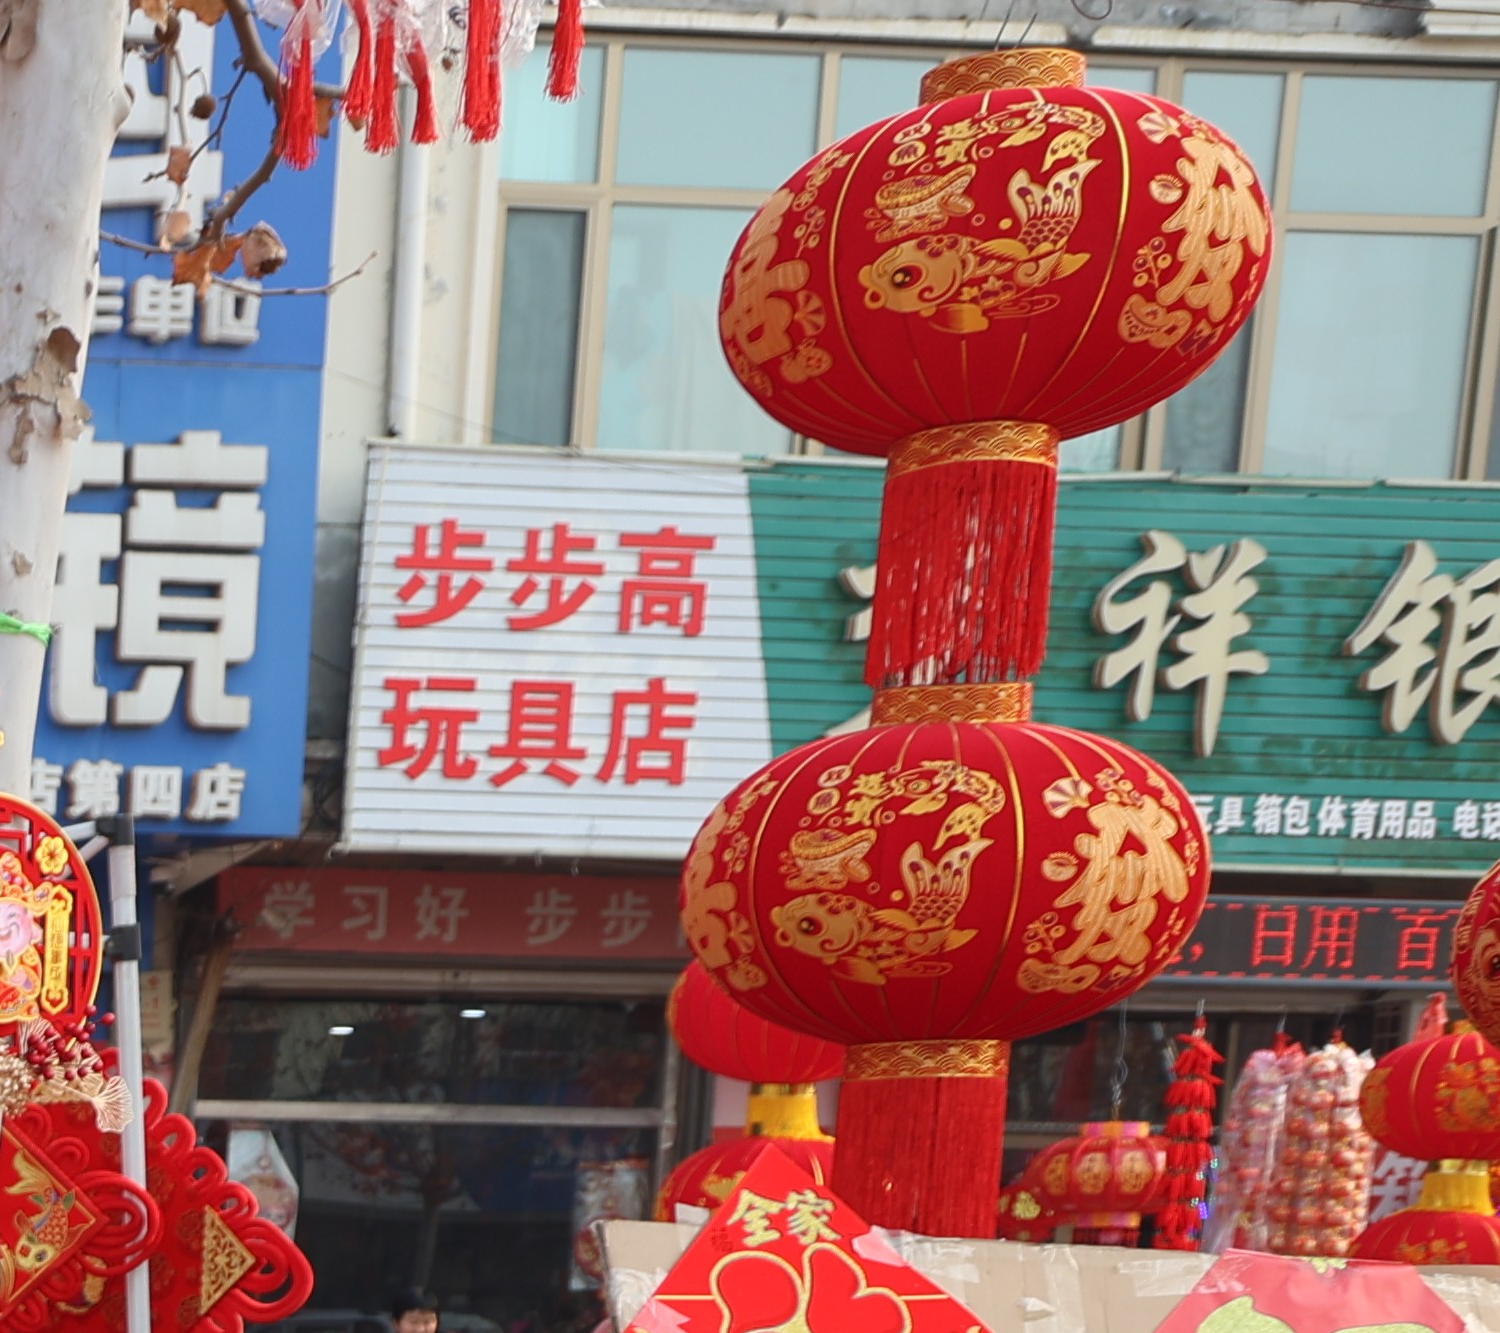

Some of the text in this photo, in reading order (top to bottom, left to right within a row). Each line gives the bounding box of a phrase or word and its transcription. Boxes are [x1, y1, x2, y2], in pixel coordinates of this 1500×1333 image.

[392, 516, 717, 638] 步步高
[376, 675, 701, 788] 玩具店
[1252, 793, 1311, 838] 箱包
[1316, 795, 1438, 840] 体育用品
[728, 1188, 838, 1249] 全家
